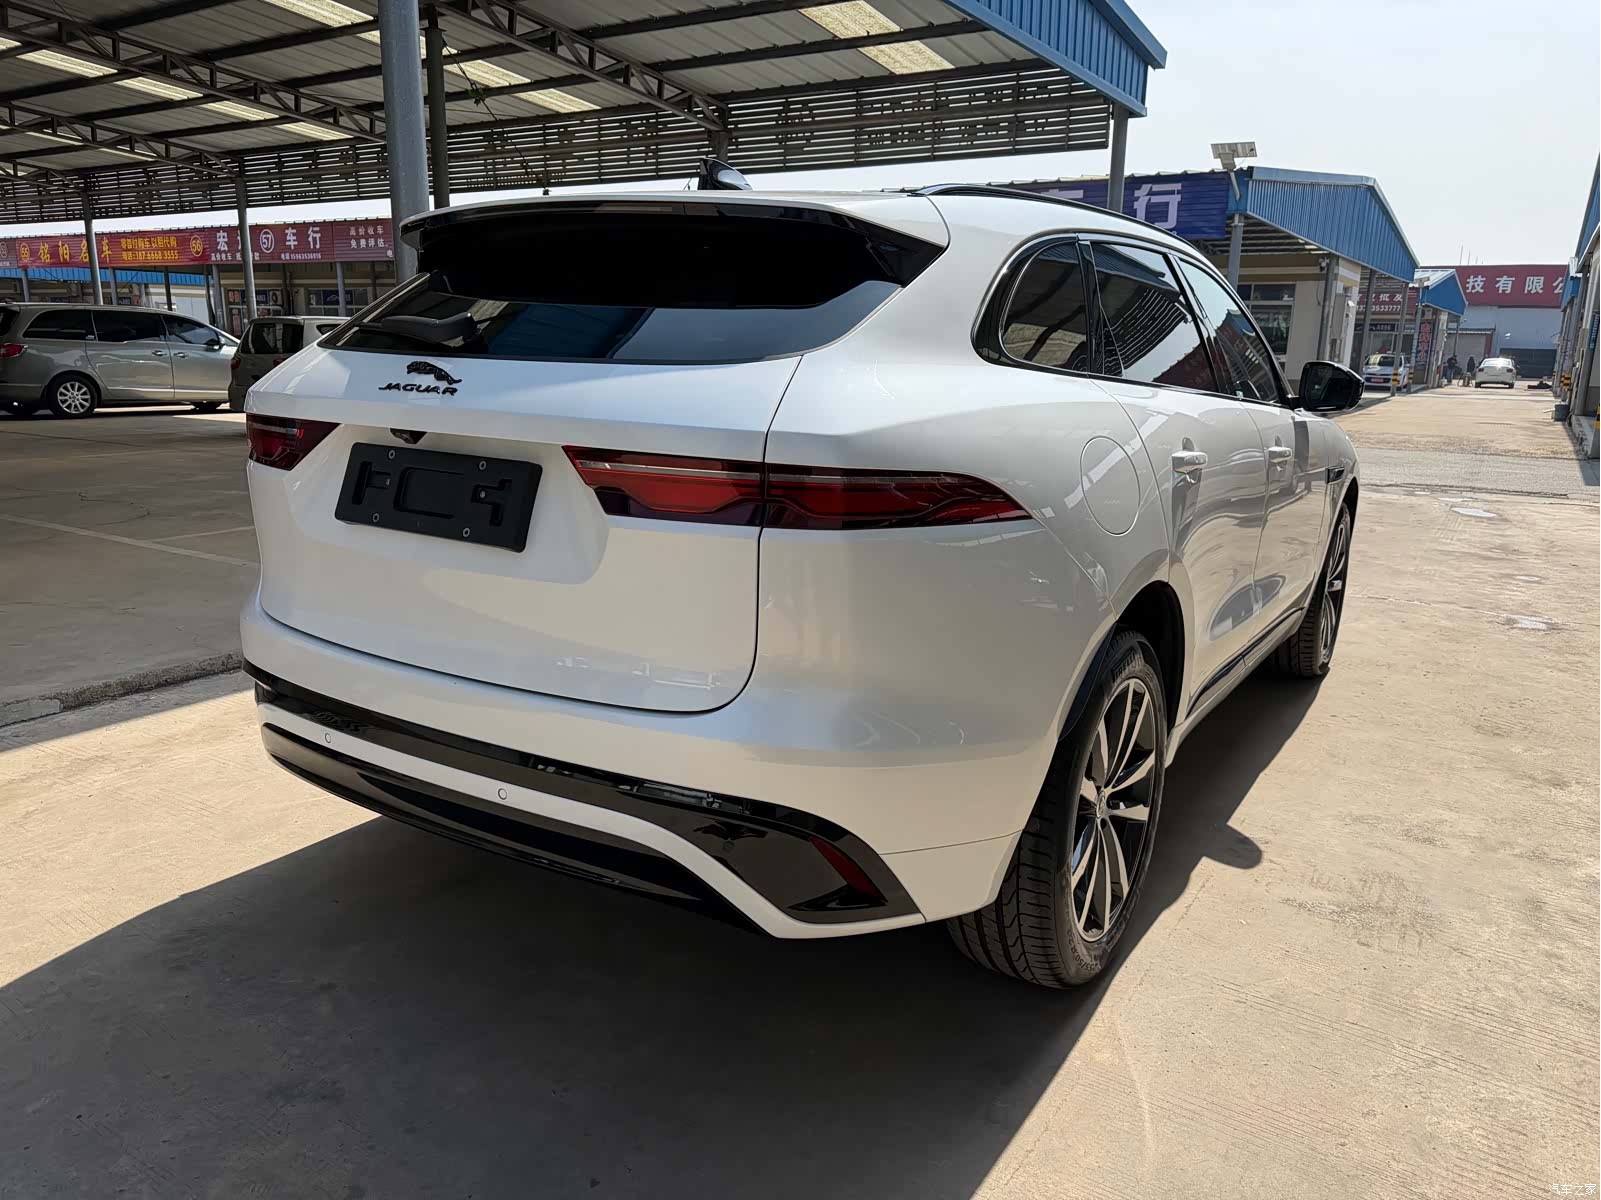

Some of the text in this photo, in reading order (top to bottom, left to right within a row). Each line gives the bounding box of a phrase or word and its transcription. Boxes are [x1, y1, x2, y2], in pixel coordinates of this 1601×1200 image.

[349, 225, 384, 236] 高价收车
[285, 226, 322, 250] 车行
[350, 237, 385, 249] 免费评估
[211, 252, 233, 261] 高价收车
[378, 382, 458, 396] JAGUAR
[1111, 648, 1136, 684] PIRELLI
